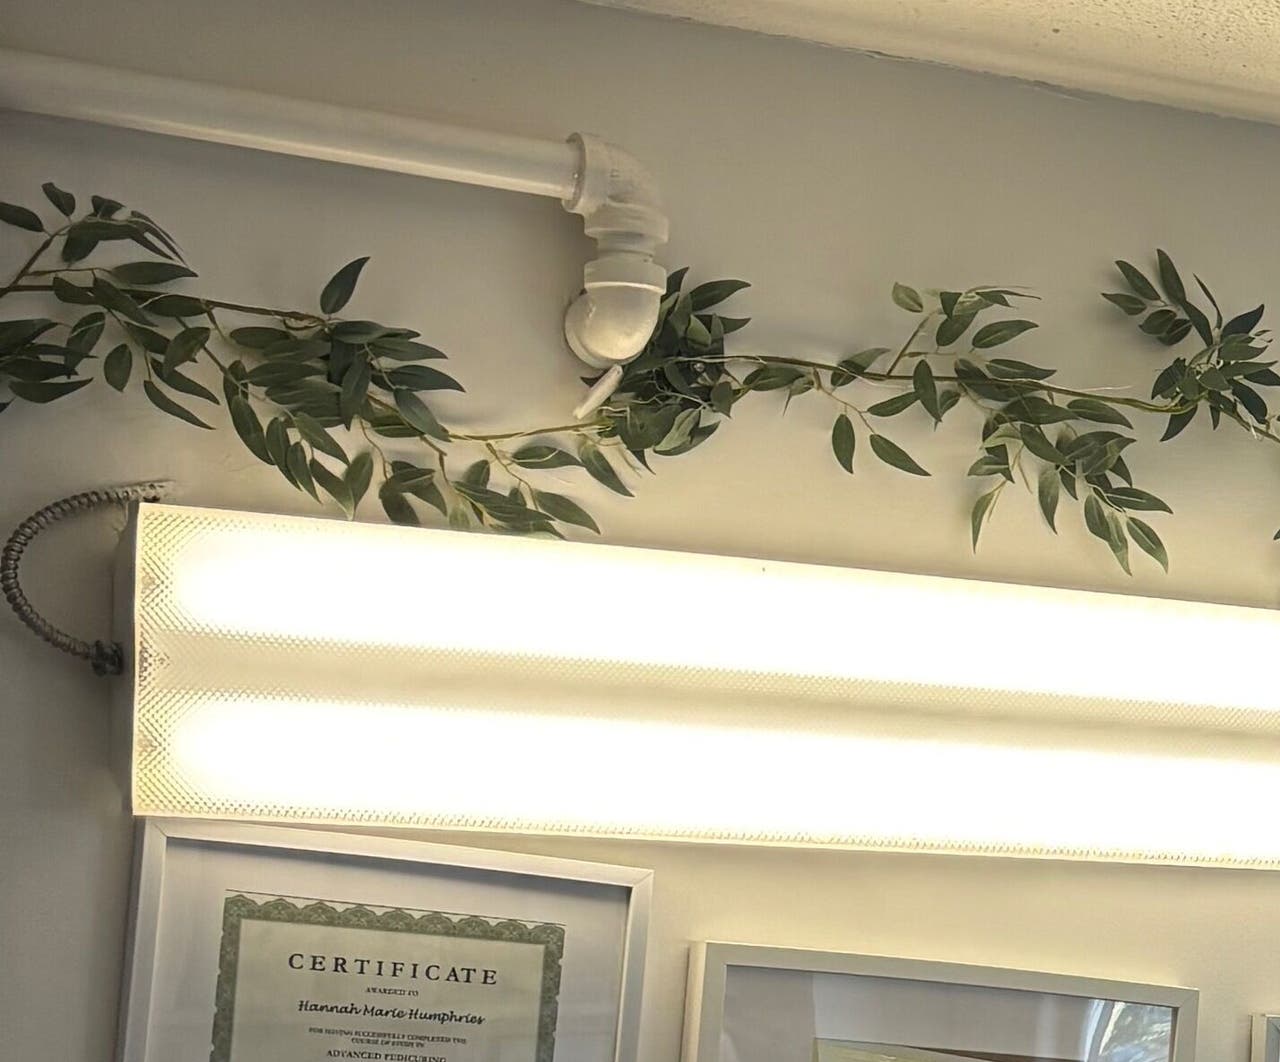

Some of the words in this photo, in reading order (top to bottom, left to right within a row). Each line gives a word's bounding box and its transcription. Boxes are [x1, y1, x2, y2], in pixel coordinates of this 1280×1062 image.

[288, 953, 497, 985] CERTIFICATE
[298, 1000, 361, 1014] Hannah
[363, 1004, 407, 1018] Marie
[408, 1009, 486, 1025] Humphries
